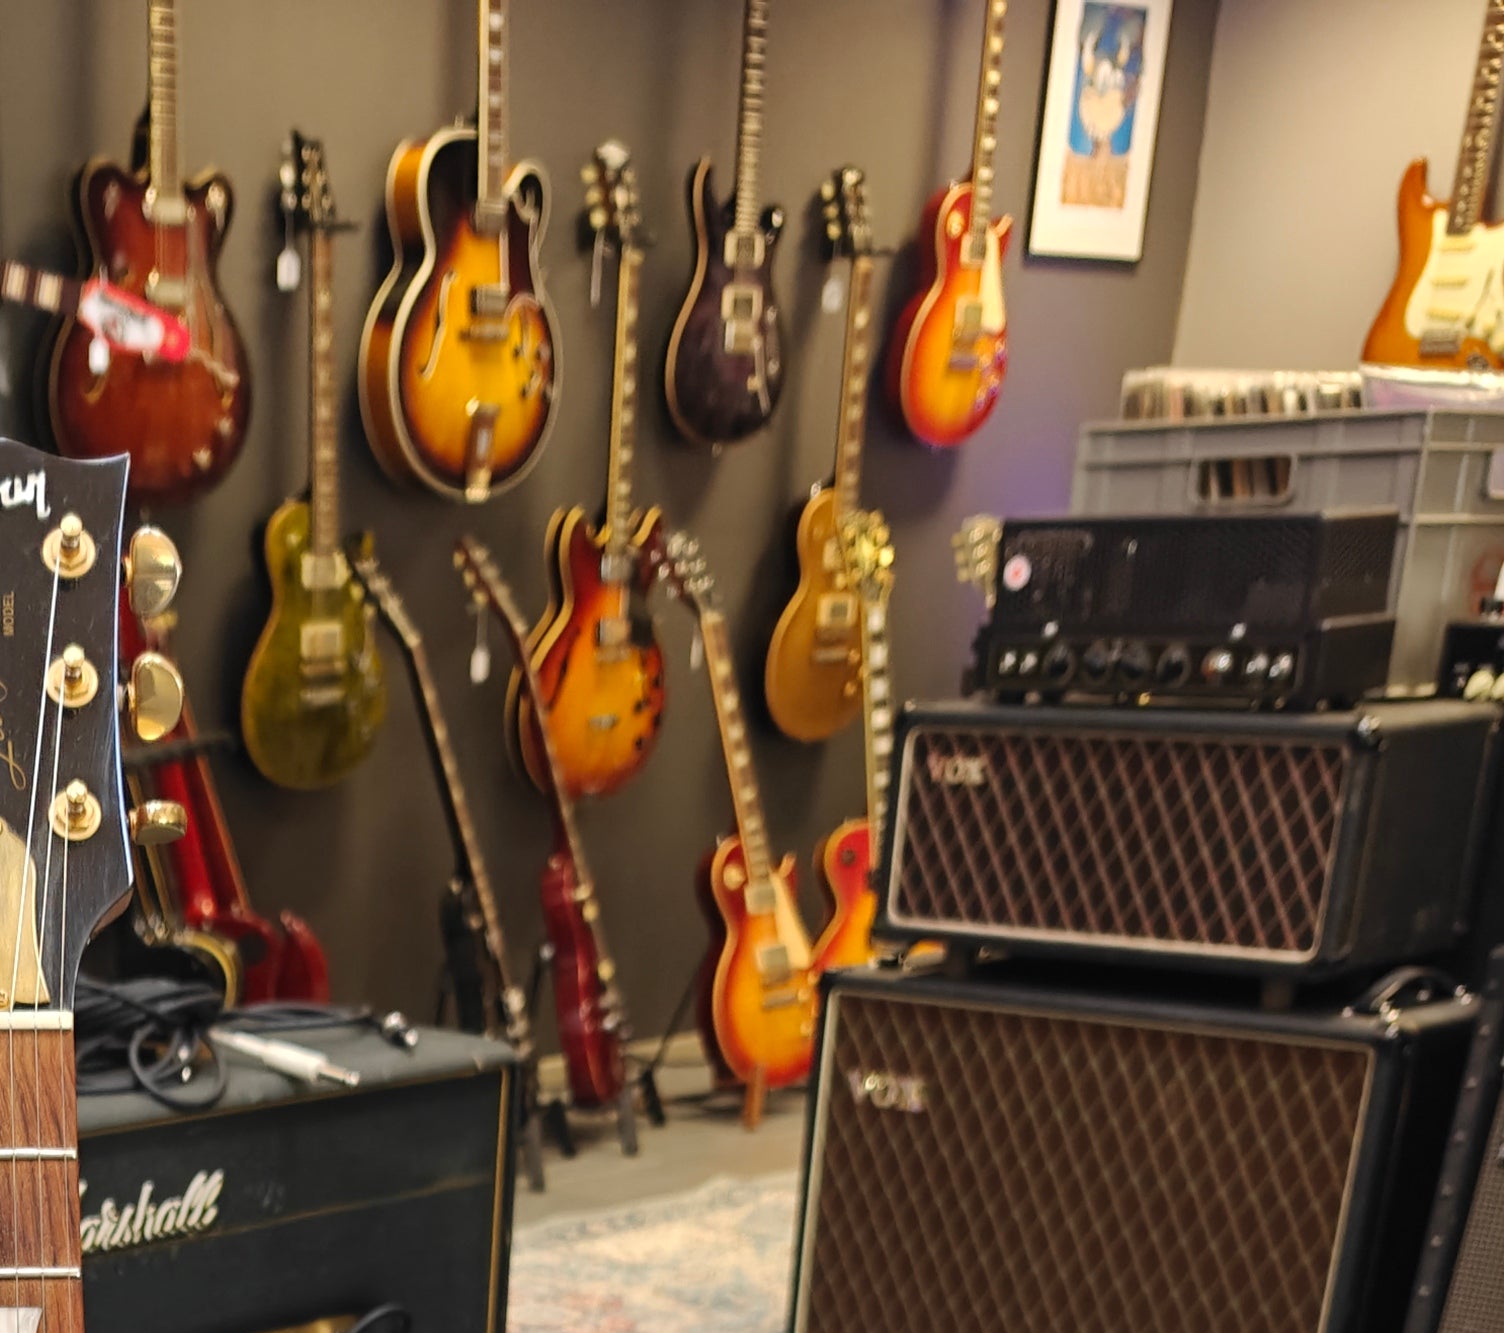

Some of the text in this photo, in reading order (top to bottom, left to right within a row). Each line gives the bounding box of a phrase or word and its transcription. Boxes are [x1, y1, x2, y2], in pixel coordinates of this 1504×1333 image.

[3, 590, 15, 638] MODEL
[926, 752, 988, 786] VOX
[847, 1070, 924, 1113] VOX
[79, 1167, 225, 1253] arshall
